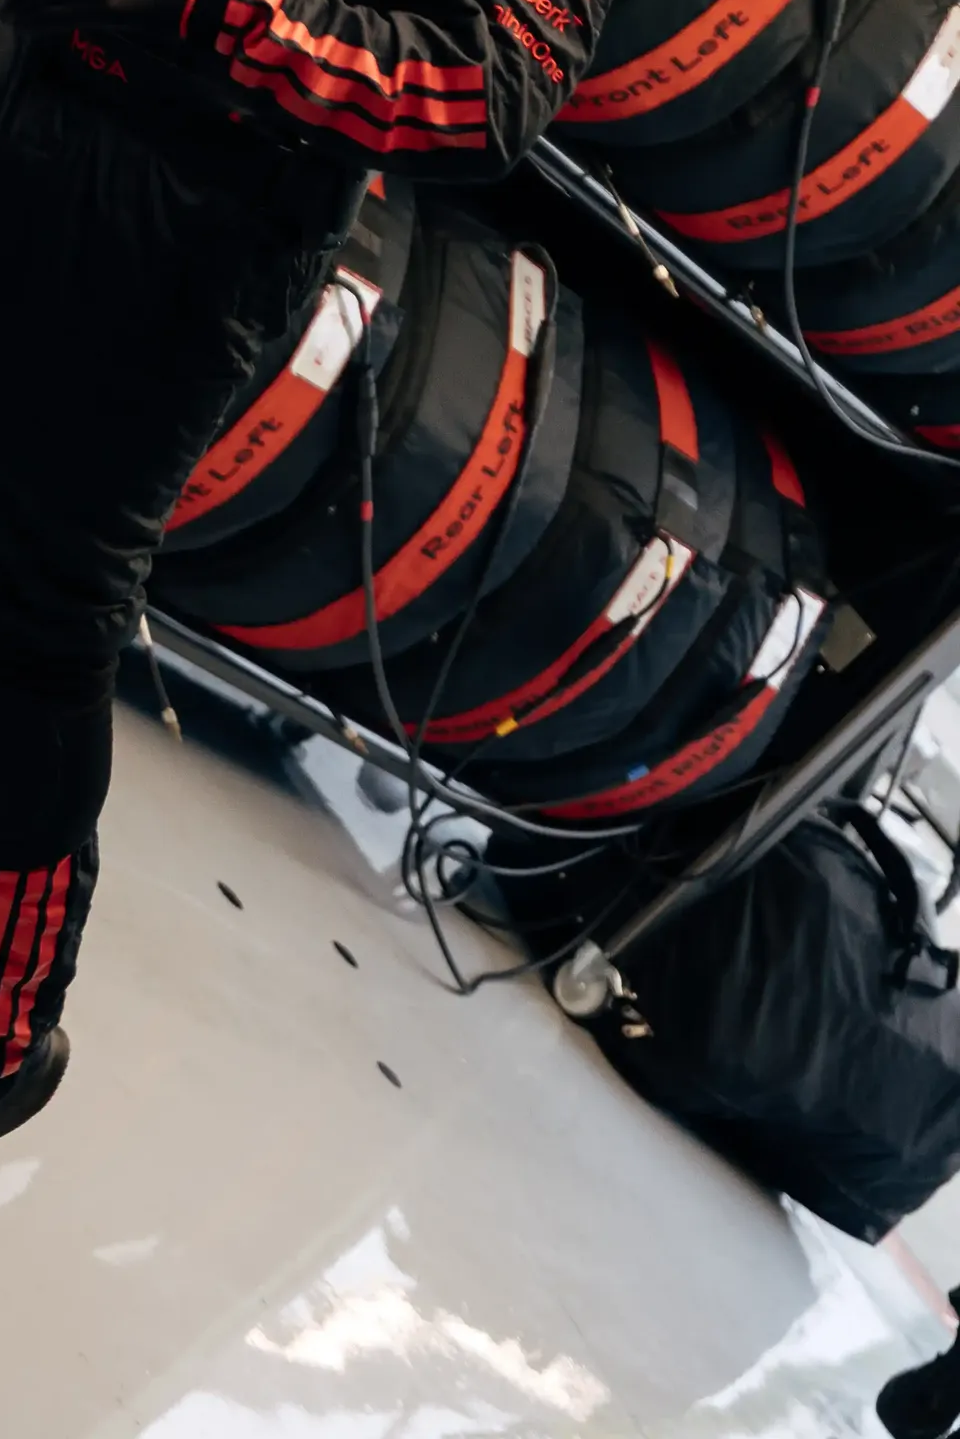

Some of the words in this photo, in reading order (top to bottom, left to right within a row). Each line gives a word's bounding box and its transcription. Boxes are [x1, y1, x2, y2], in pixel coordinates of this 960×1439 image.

[669, 10, 750, 73] Left
[816, 138, 891, 195] Left
[207, 416, 284, 481] Left
[420, 484, 485, 560] Rear
[481, 399, 524, 479] Left
